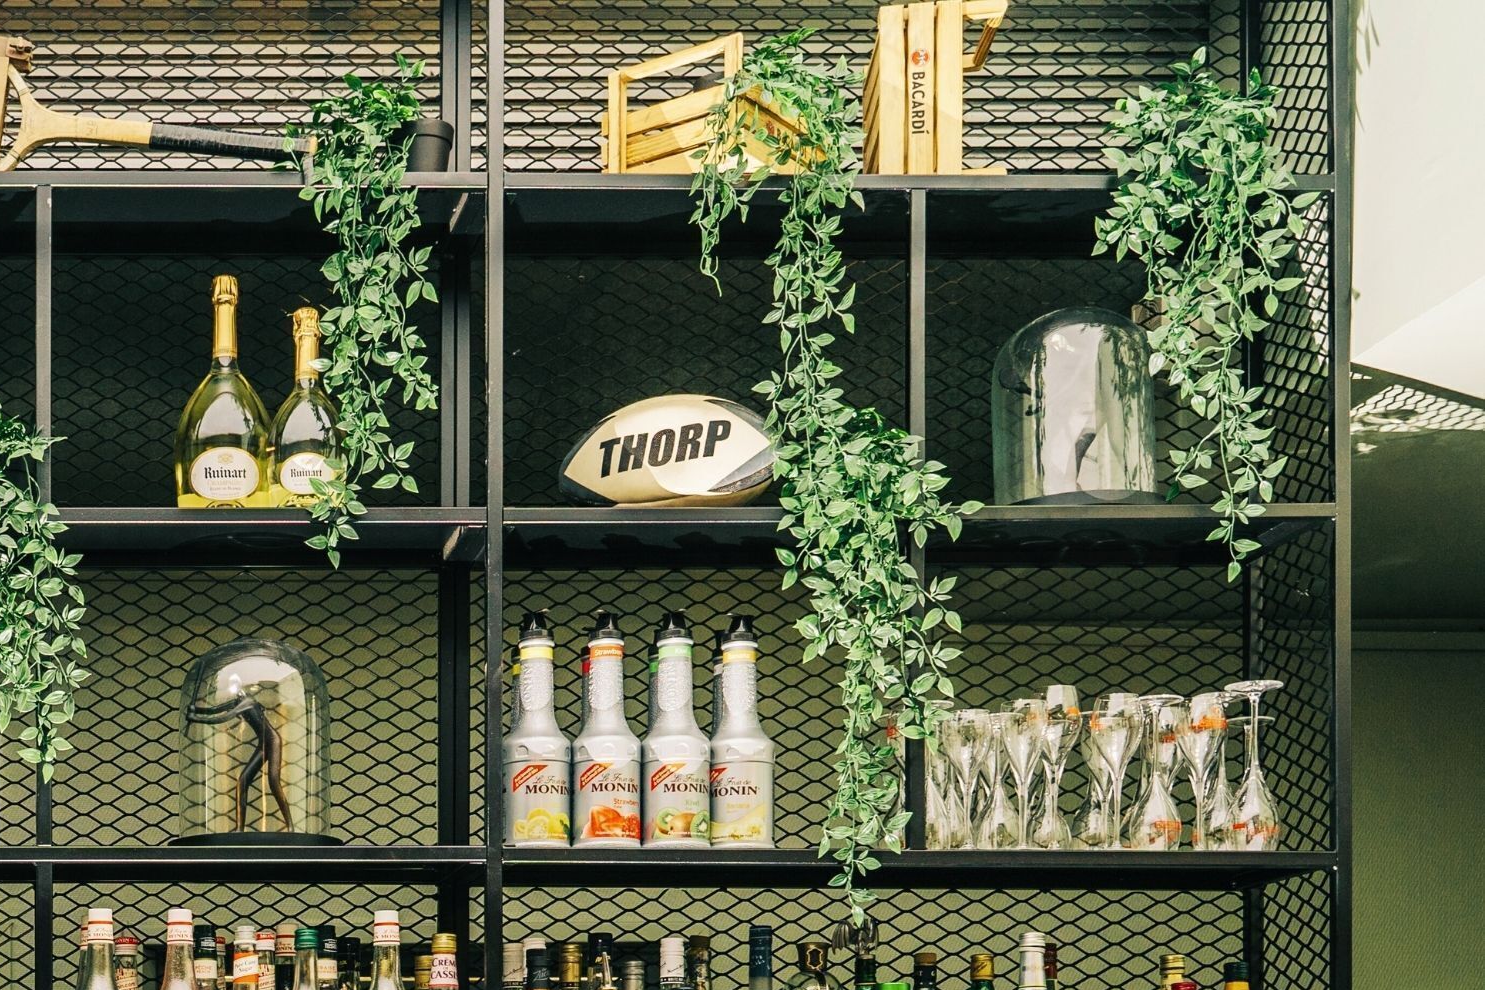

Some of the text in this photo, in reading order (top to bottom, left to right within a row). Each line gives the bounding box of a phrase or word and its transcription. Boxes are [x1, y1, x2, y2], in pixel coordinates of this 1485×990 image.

[599, 419, 732, 479] THORP
[204, 466, 248, 480] Ruinart
[290, 468, 323, 479] Ruinart
[591, 782, 639, 794] MONIN
[432, 957, 456, 967] CRÈM
[430, 971, 457, 980] CASSI
